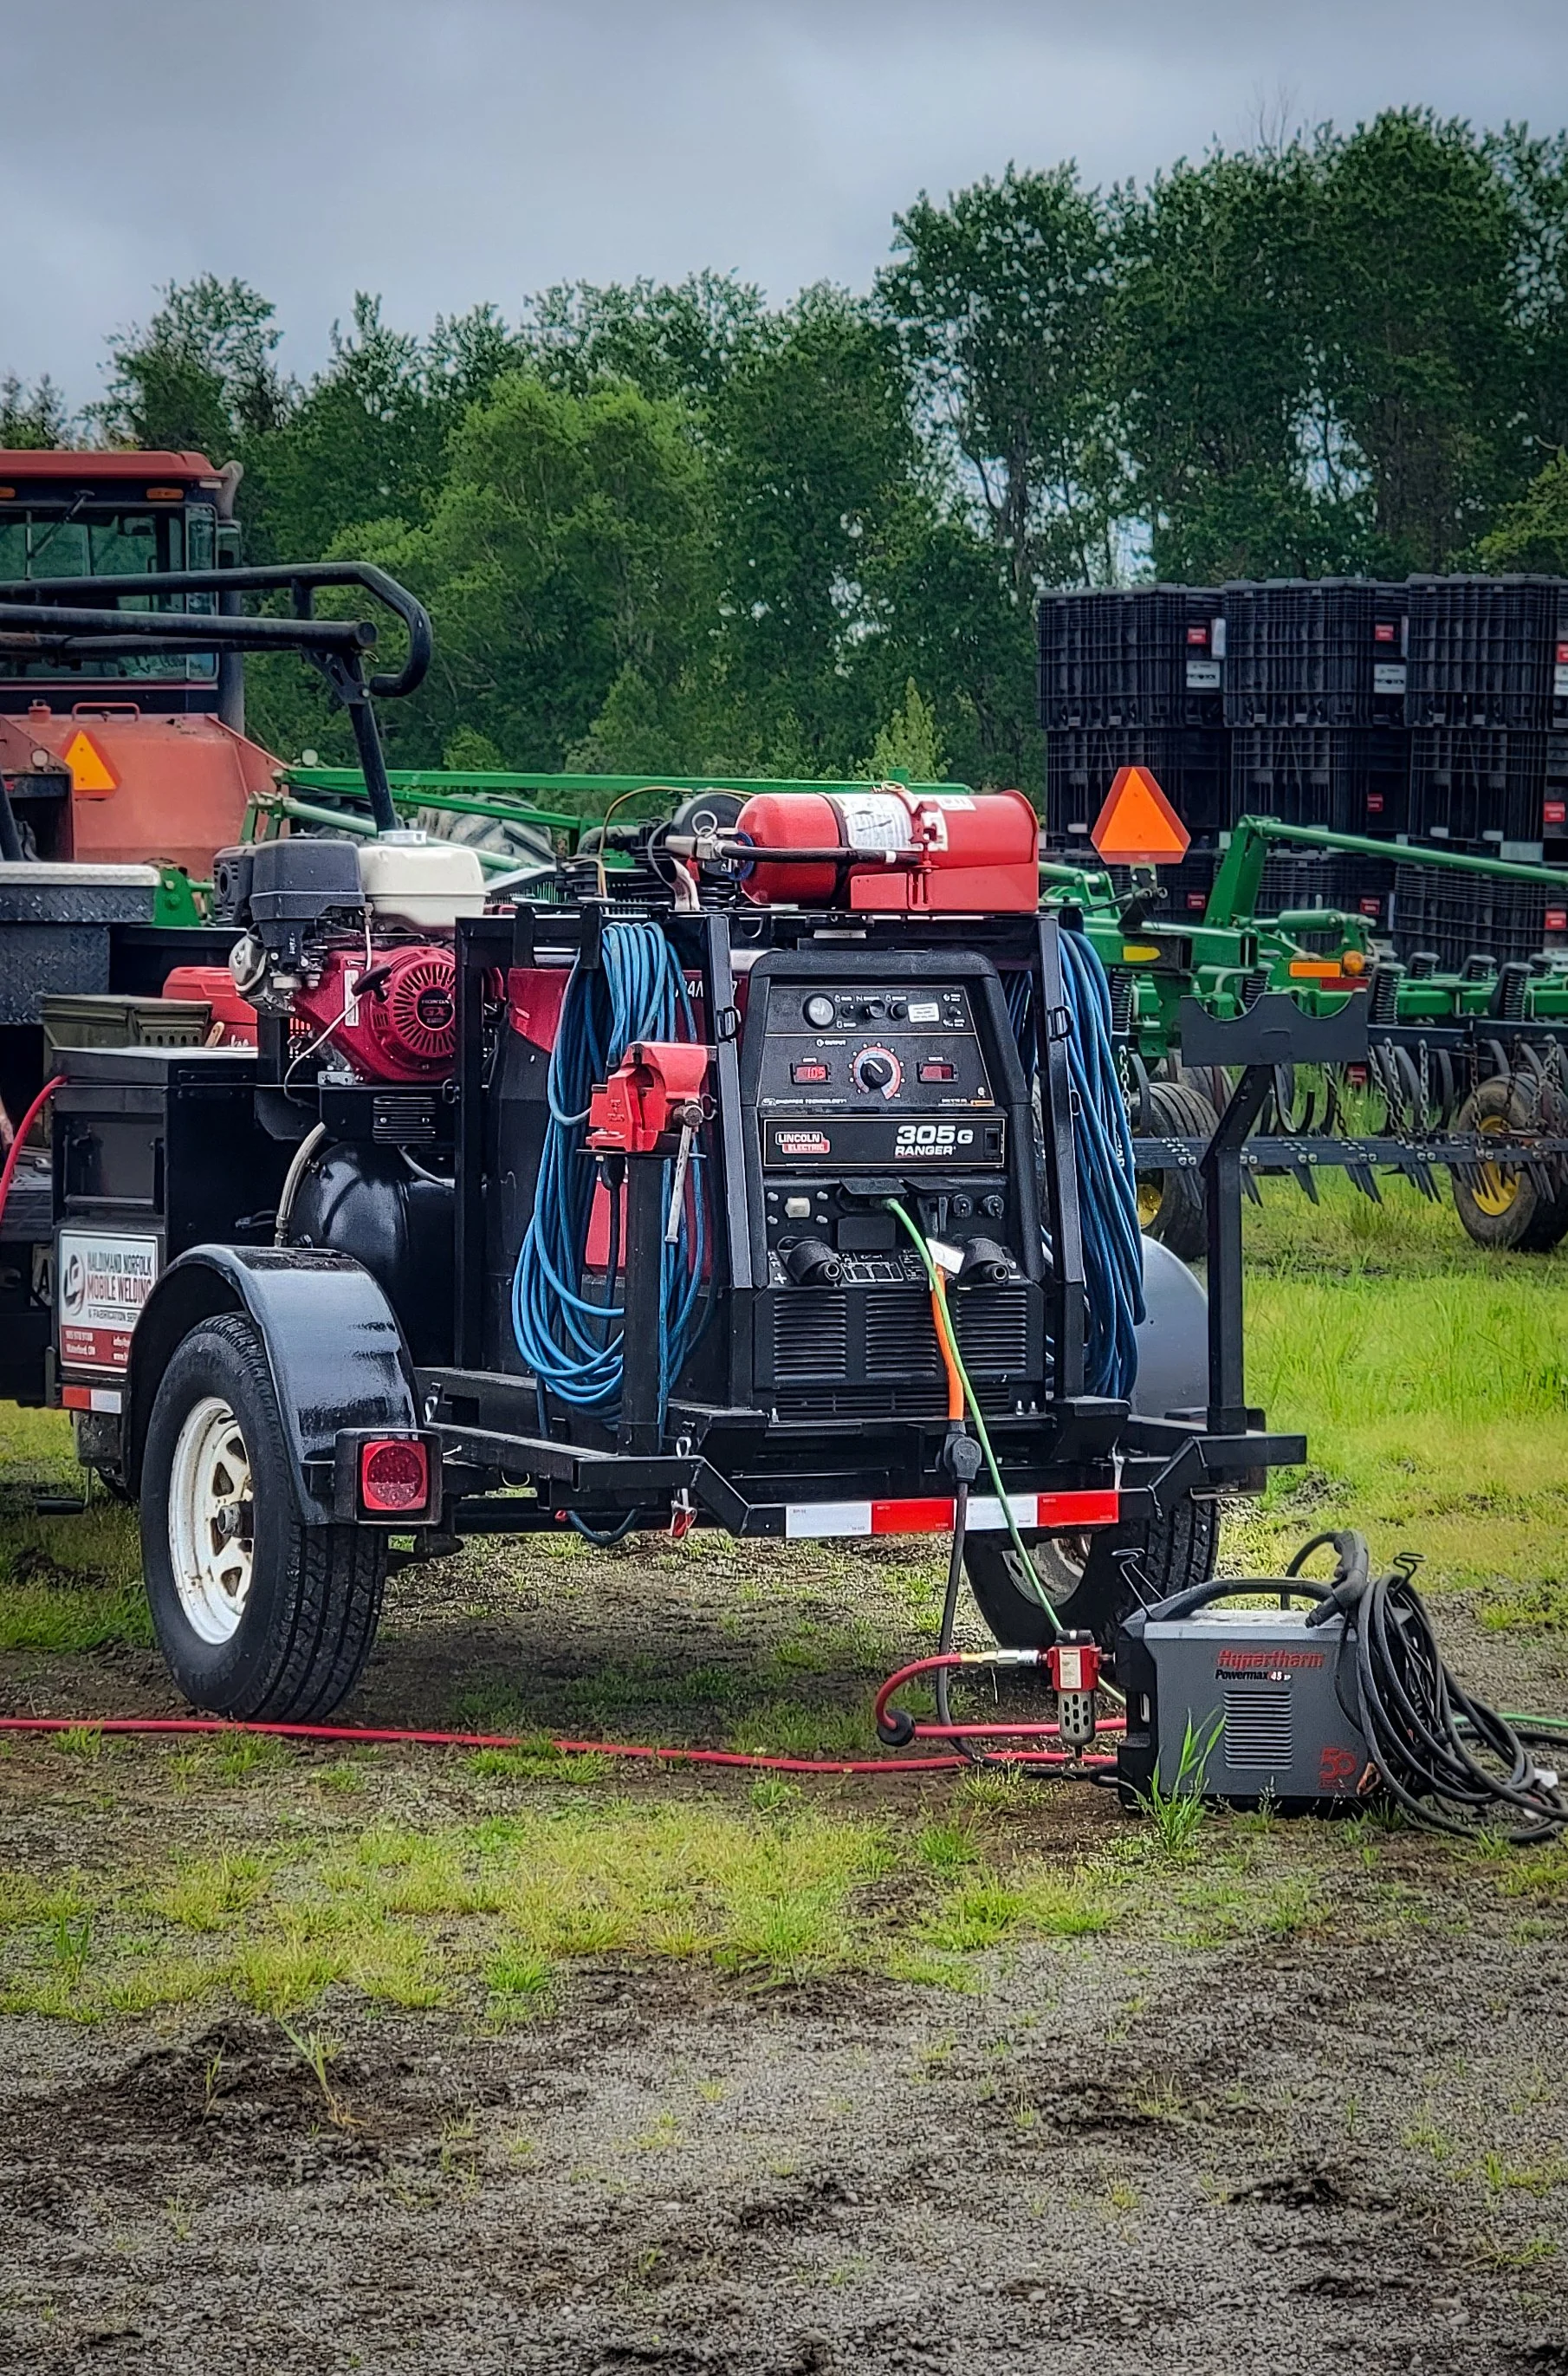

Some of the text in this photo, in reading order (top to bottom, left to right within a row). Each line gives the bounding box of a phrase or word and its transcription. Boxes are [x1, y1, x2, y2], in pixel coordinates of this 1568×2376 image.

[778, 1133, 820, 1143] LINCOLN
[787, 1143, 825, 1152] ELECTRIC
[894, 1145, 956, 1156] RANGER
[87, 1274, 116, 1301] MOBILE
[1217, 1649, 1324, 1671] Hypertherm
